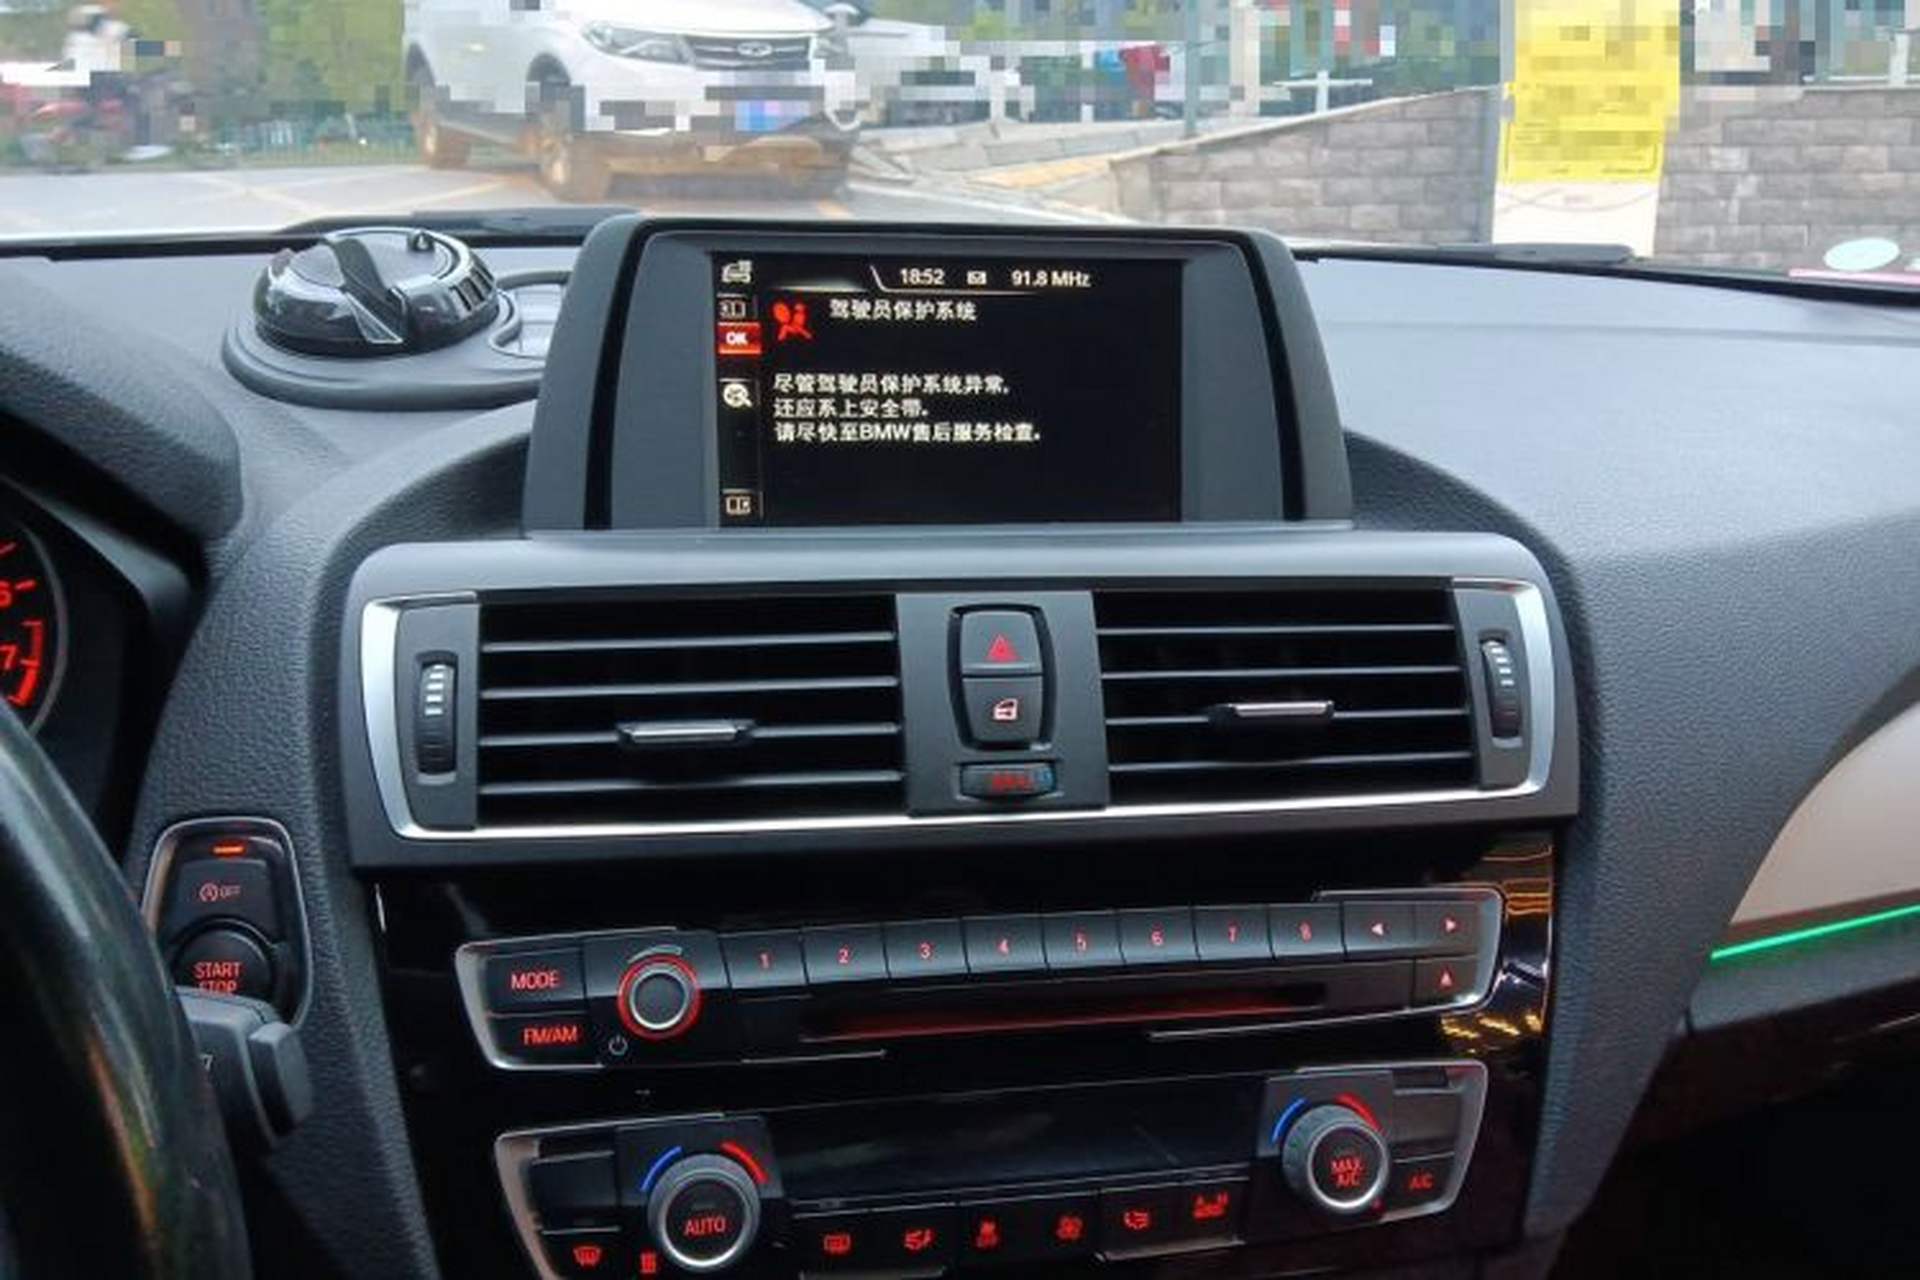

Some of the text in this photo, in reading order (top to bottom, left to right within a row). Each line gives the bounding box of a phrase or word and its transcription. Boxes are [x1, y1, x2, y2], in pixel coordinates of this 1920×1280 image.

[899, 267, 945, 286] 18:52
[1011, 268, 1091, 288] 91.8 MHz
[829, 299, 978, 321] 驾驶员保护系统
[725, 331, 749, 345] OK
[0, 644, 17, 671] 7
[760, 952, 771, 970] 1
[838, 947, 850, 965] 2
[919, 942, 932, 960] 3
[1075, 931, 1088, 952] 5
[1151, 928, 1164, 947] 6
[194, 961, 242, 979] START
[511, 970, 560, 990] MODE
[523, 1025, 577, 1046] FM/AM
[683, 1216, 726, 1237] AUTO
